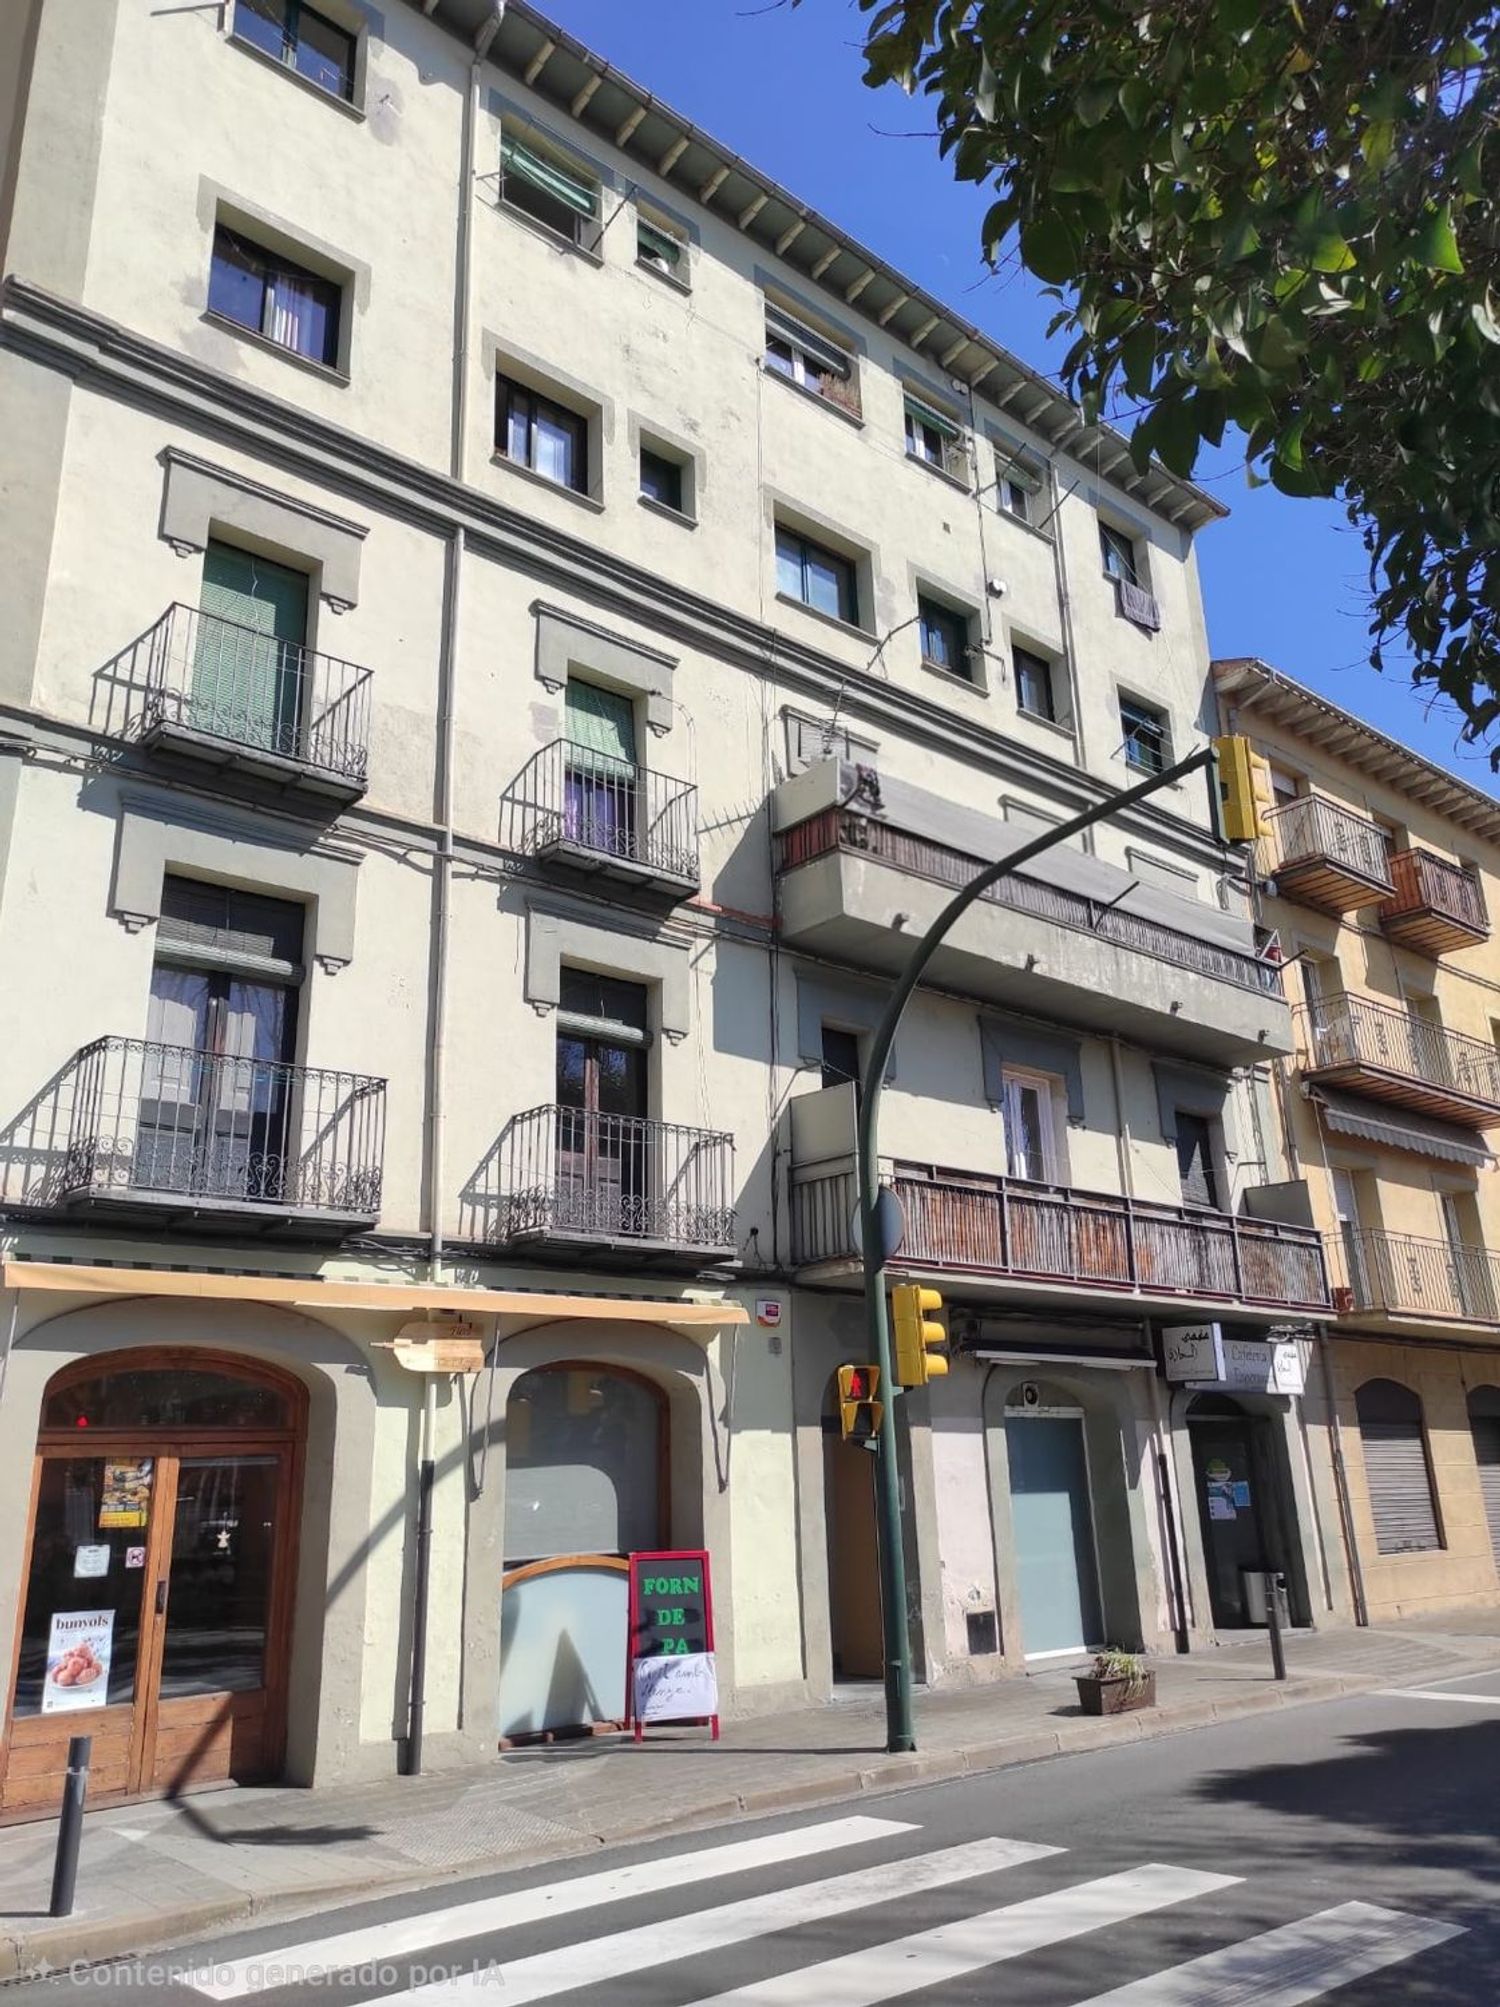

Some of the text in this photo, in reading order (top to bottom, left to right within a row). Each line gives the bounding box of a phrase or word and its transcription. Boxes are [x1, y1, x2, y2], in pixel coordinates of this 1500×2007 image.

[643, 1577, 699, 1595] FORN
[56, 1616, 108, 1630] bunyols
[658, 1608, 685, 1626] DE
[662, 1638, 689, 1654] PA
